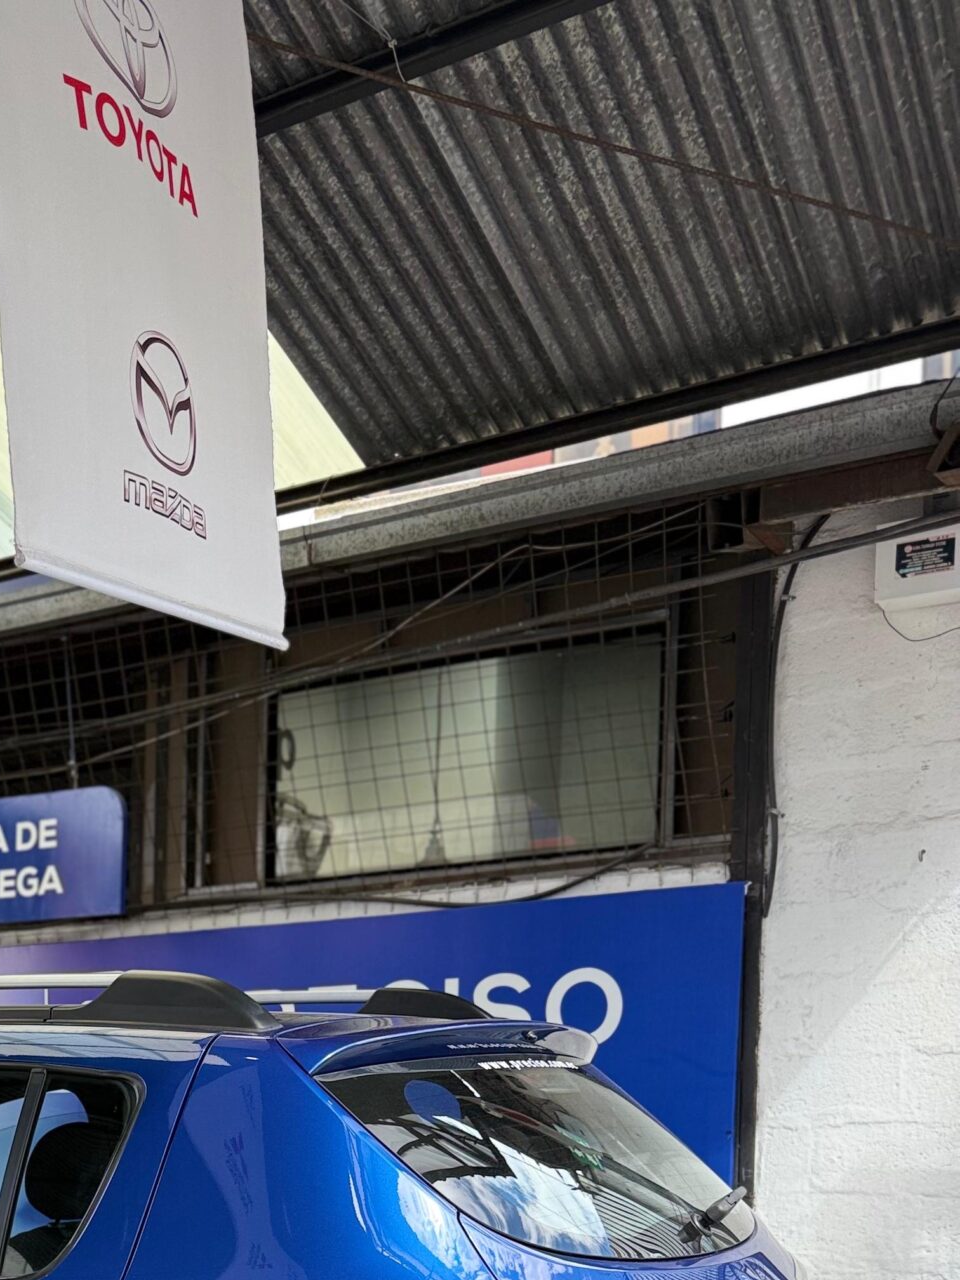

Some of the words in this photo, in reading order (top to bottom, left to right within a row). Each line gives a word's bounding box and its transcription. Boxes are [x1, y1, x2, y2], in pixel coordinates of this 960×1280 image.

[62, 73, 199, 218] TOYOTA
[123, 469, 208, 540] mazda
[15, 818, 58, 851] DE
